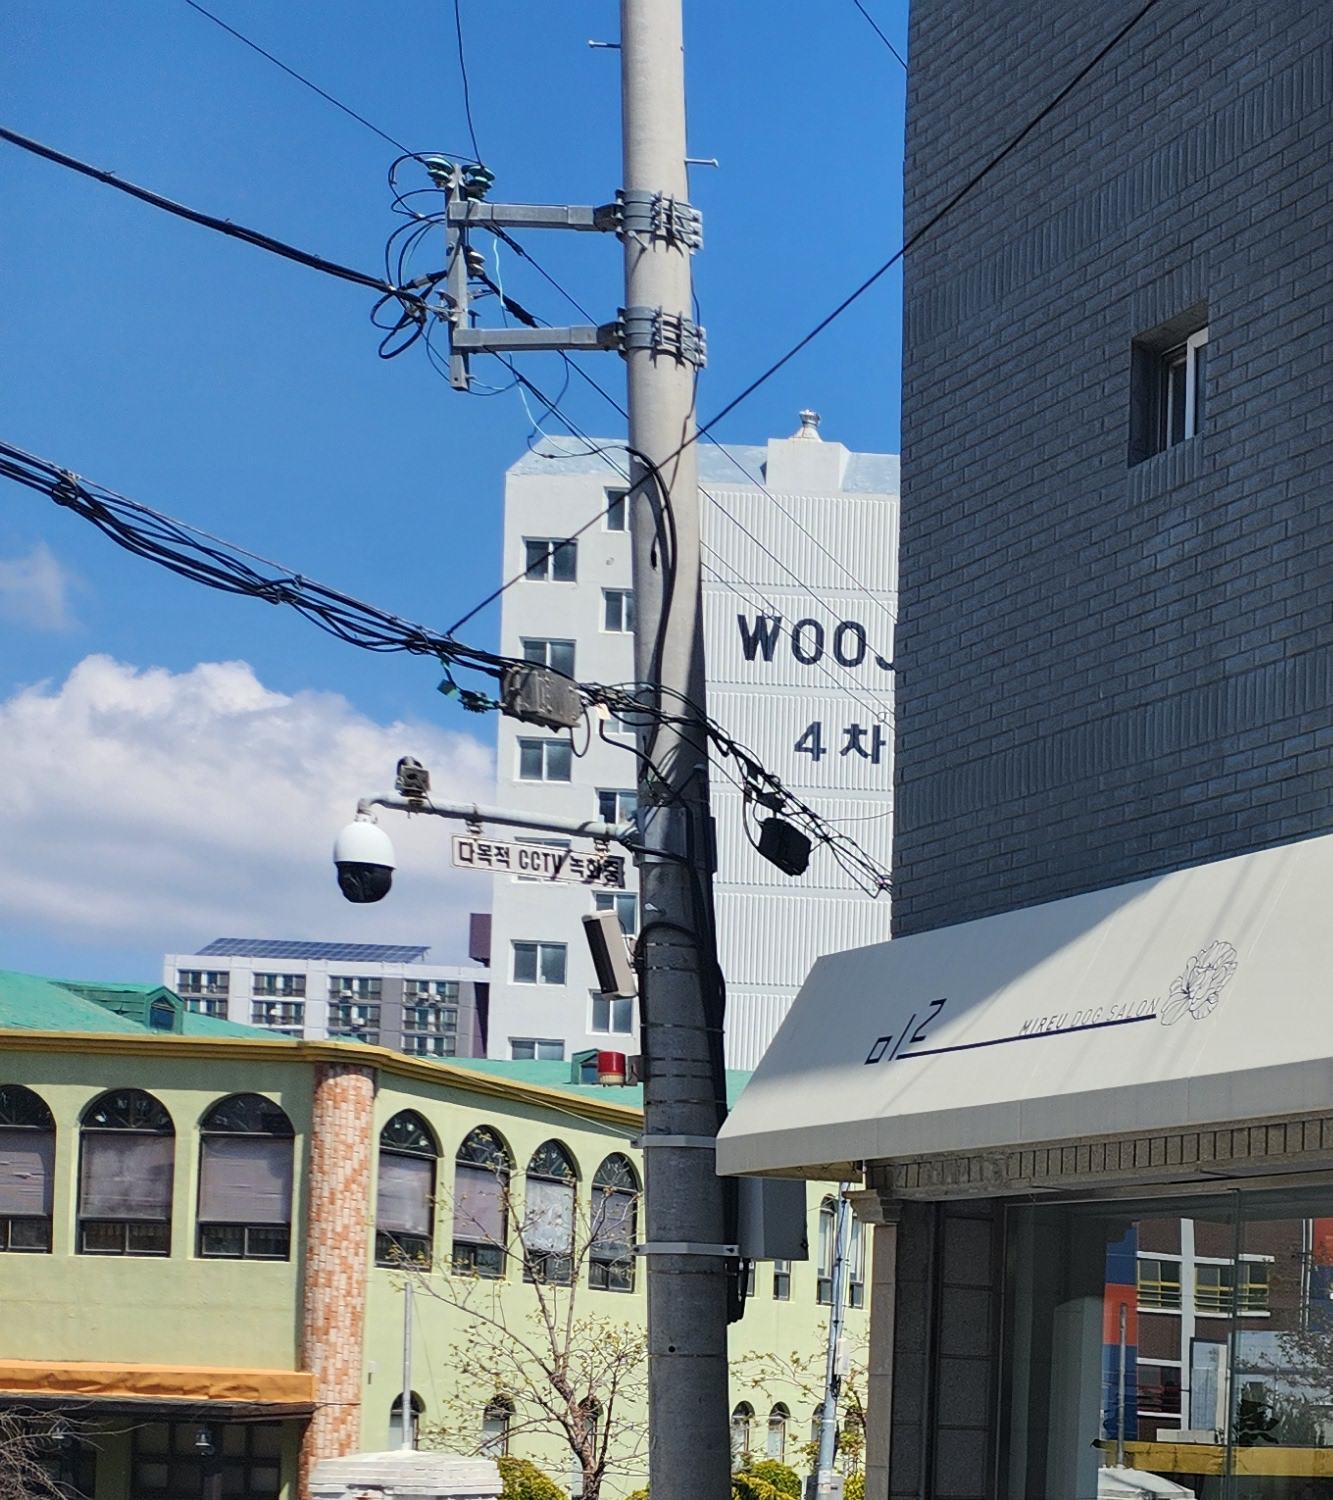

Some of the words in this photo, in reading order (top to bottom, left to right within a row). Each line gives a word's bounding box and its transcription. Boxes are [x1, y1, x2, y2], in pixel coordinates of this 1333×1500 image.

[458, 840, 510, 869] 다목적
[518, 849, 567, 874] CCTV
[569, 854, 620, 887] 녹화중
[1017, 1013, 1068, 1036] MIREU
[1069, 1005, 1104, 1027] DOG
[1105, 996, 1161, 1020] SALON
